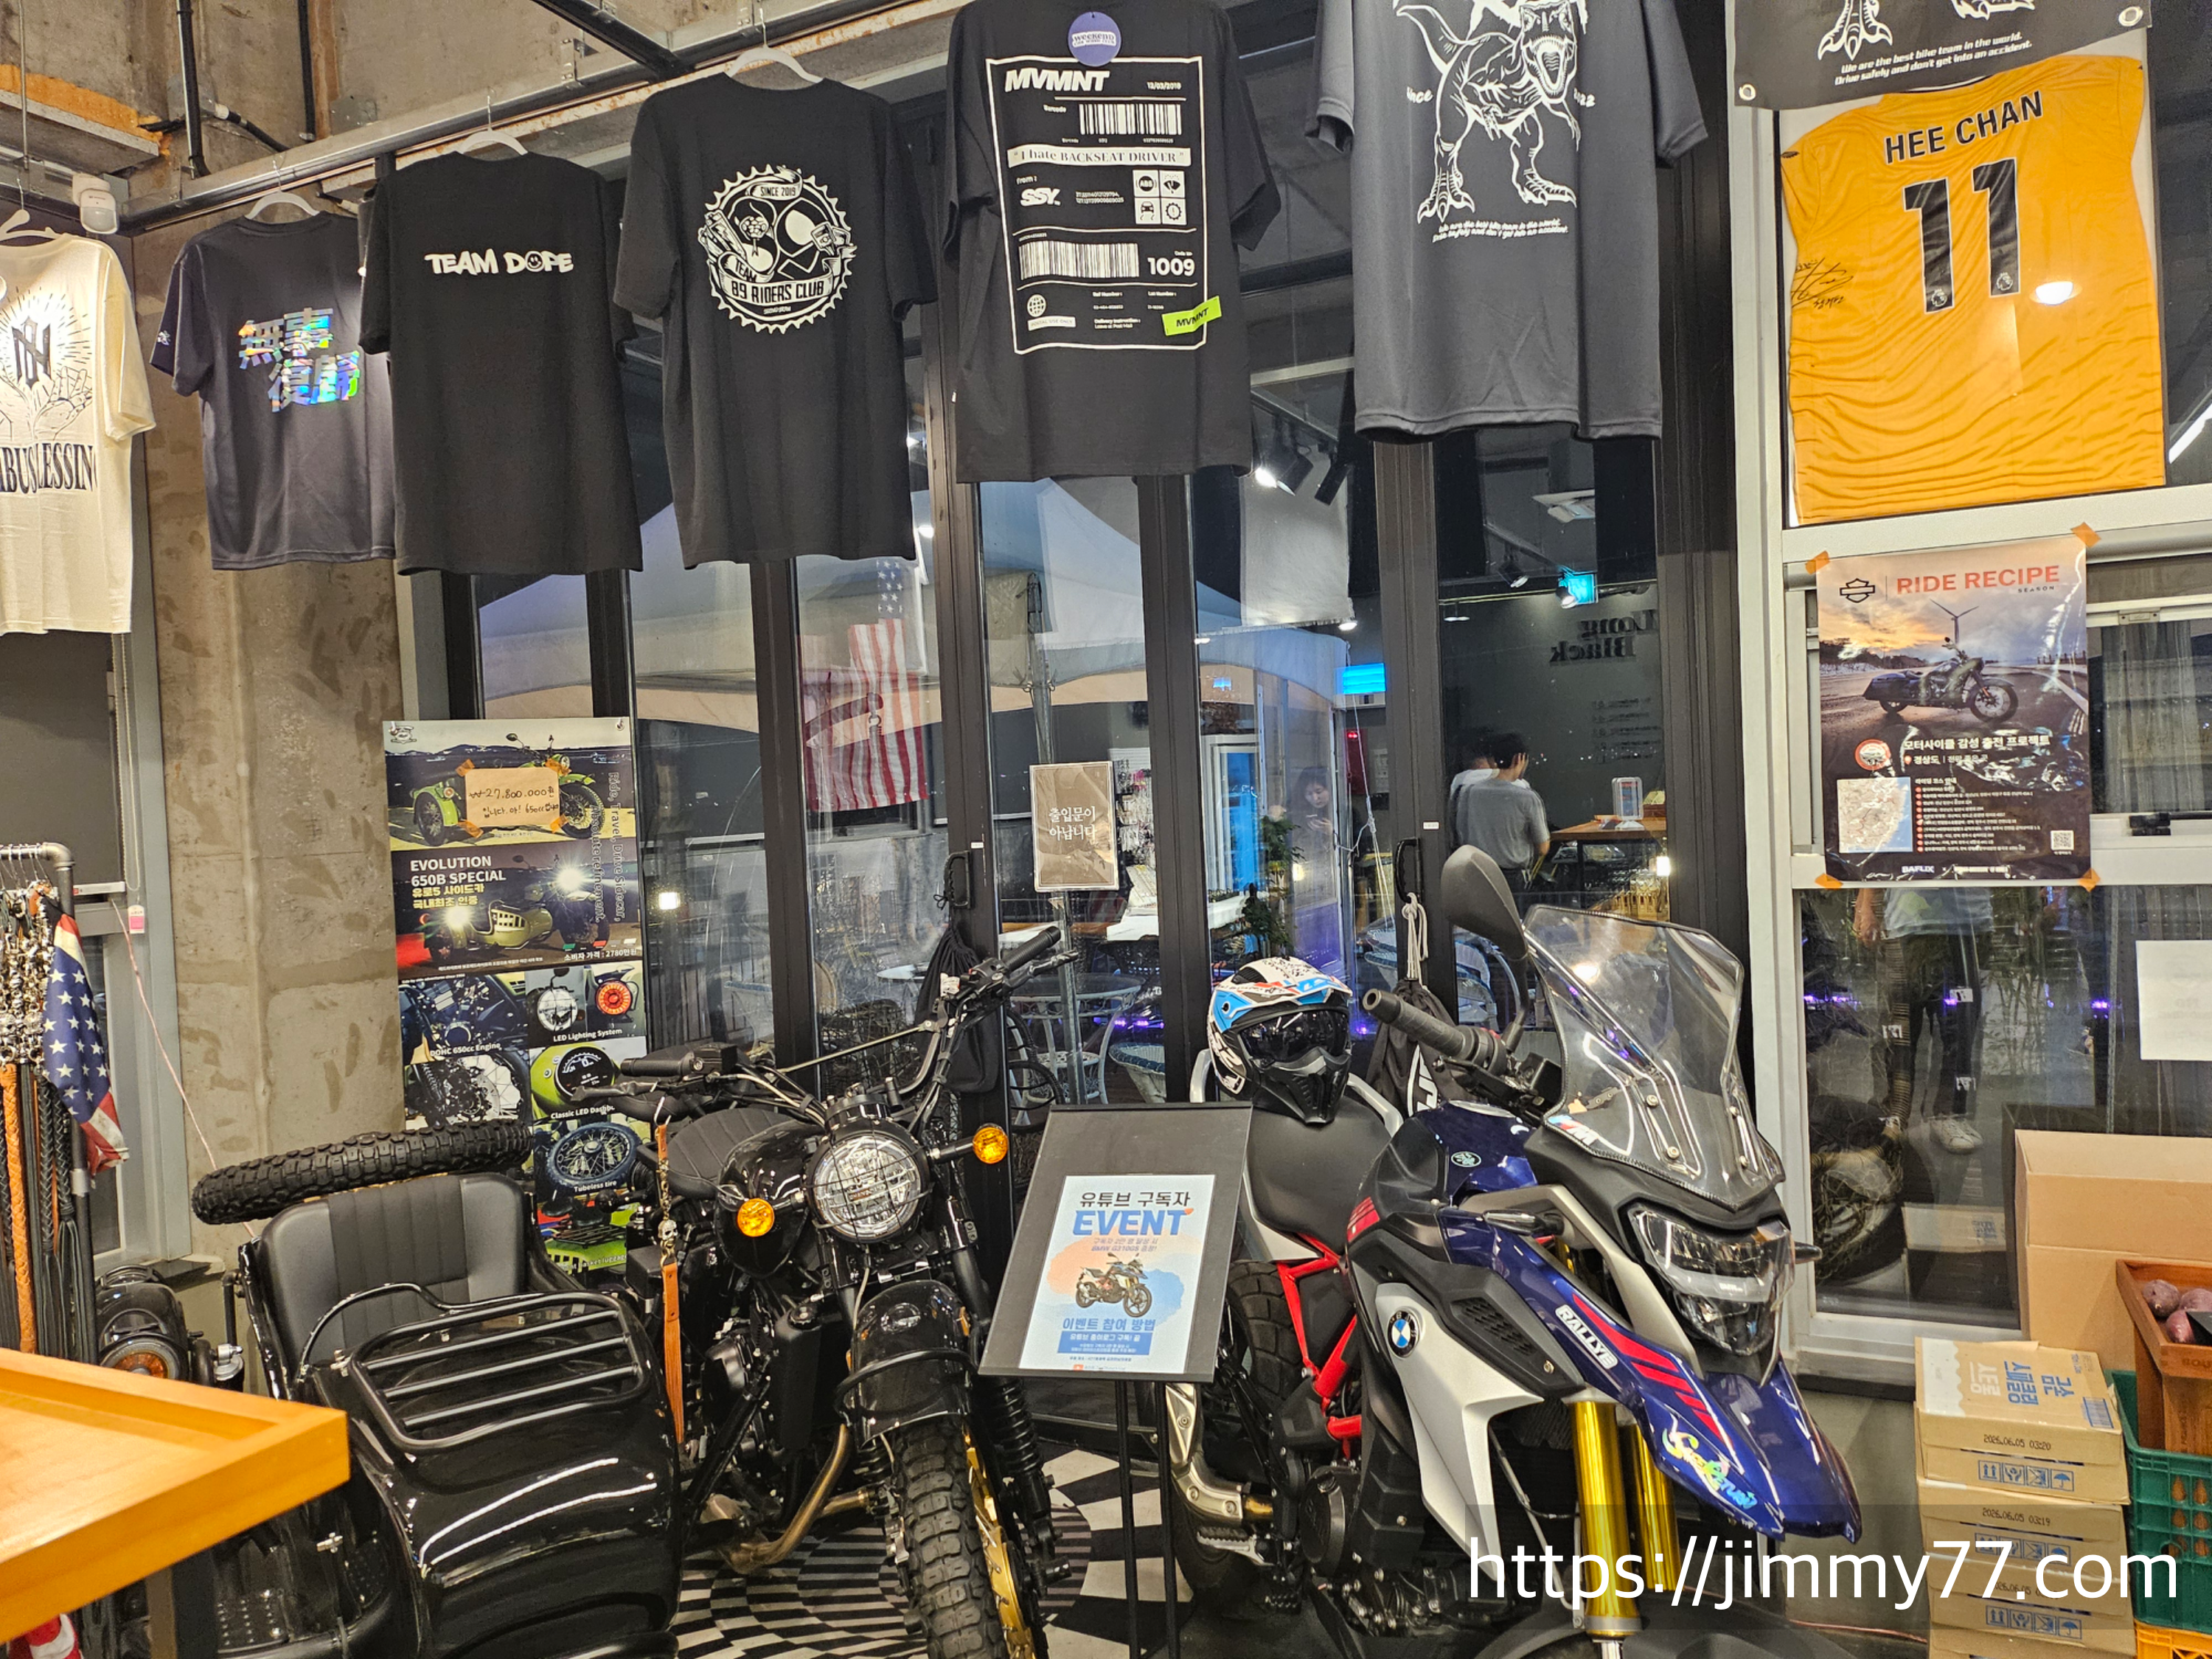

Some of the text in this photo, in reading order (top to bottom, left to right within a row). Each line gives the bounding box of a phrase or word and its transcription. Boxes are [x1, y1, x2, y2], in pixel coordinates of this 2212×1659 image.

[1841, 63, 1857, 73] We
[1858, 61, 1874, 70] are
[1875, 56, 1892, 67] the
[1893, 51, 1915, 63] best
[1916, 48, 1936, 60] bike
[1938, 44, 1962, 55] team
[1964, 41, 1974, 50] in
[1974, 38, 1991, 49] the
[1834, 74, 1860, 86] Drive
[1860, 68, 1889, 81] safely
[1891, 63, 1910, 74] and
[1935, 55, 1953, 68] get
[1954, 52, 1973, 63] into
[1974, 49, 1987, 59] an
[1005, 68, 1110, 92] MVMNT
[1885, 90, 2042, 165] HEE CHAN
[1029, 148, 1057, 161] hate
[1060, 152, 1124, 162] BACKSEAT
[1129, 152, 1177, 162] DRIVER
[760, 187, 796, 197] SINCE 2019
[1903, 157, 2021, 315] 11
[425, 248, 574, 275] TEAM DOPE
[735, 257, 757, 282] TEAM
[1147, 257, 1195, 276] 1009
[731, 280, 824, 303] 89 RIDERS CLUB
[1176, 307, 1209, 327] MVMNT
[1896, 565, 2059, 595] RIDE RECIPE
[2018, 585, 2055, 594] SEASON
[1958, 738, 1979, 749] 감성
[2006, 735, 2051, 748] 프로젝트
[1048, 805, 1096, 823] 출입문이
[411, 856, 492, 872] EVOLUTION
[613, 844, 624, 874] Drive
[411, 870, 507, 887] 650B SPECIAL
[412, 883, 484, 898] 유로5 사이드카
[613, 875, 626, 922] Sidecar,
[564, 953, 585, 961] 소비자
[553, 1029, 622, 1042] LED Lighting System
[453, 1046, 474, 1054] 650cc
[476, 1043, 501, 1053] Engine
[551, 1110, 574, 1119] Classic
[575, 1107, 589, 1116] LED
[574, 1183, 604, 1192] Tubeless
[1080, 1191, 1191, 1208] 유튜브 구독자
[1072, 1209, 1189, 1236] EVENT
[1062, 1318, 1156, 1331] 이벤트 참여 방법
[1557, 1307, 1616, 1367] RALLYE
[2004, 1360, 2039, 1405] 스파클링
[1983, 1434, 2052, 1450] 2026.06.05 03:20
[1982, 1507, 2051, 1526] 2026.06.05 03:19
